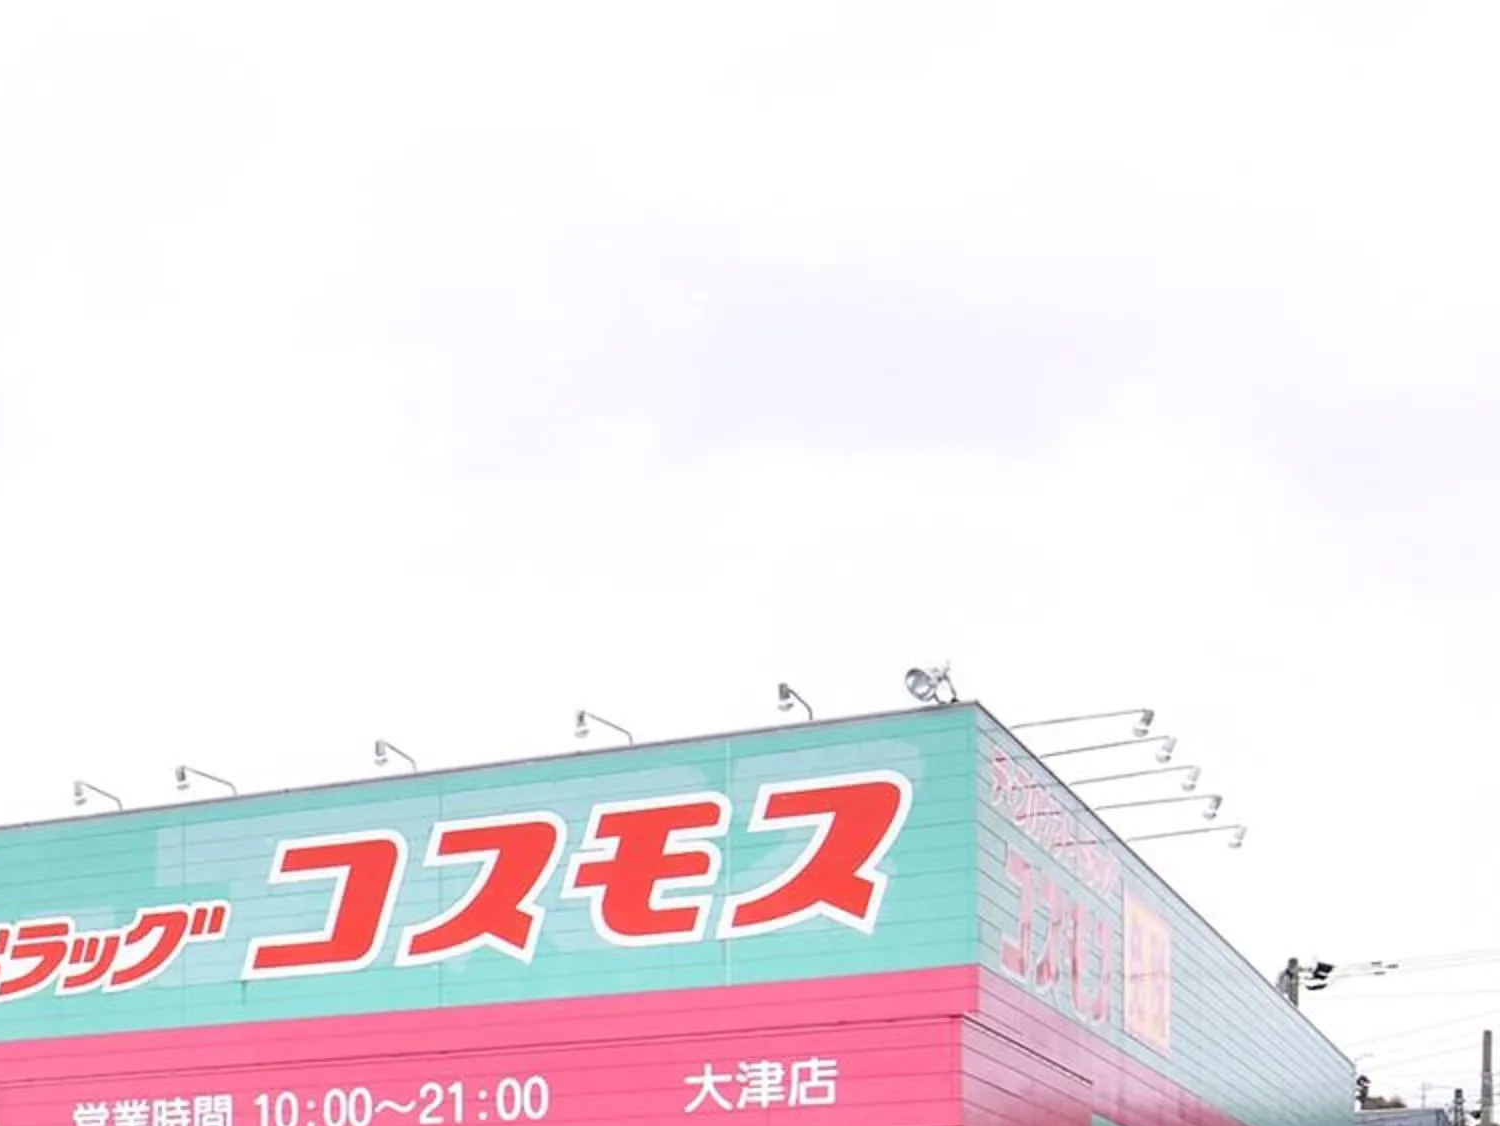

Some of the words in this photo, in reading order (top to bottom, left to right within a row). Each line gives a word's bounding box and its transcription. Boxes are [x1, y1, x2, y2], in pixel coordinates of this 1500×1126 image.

[248, 775, 907, 973] コスモス
[683, 1058, 838, 1114] 大津店
